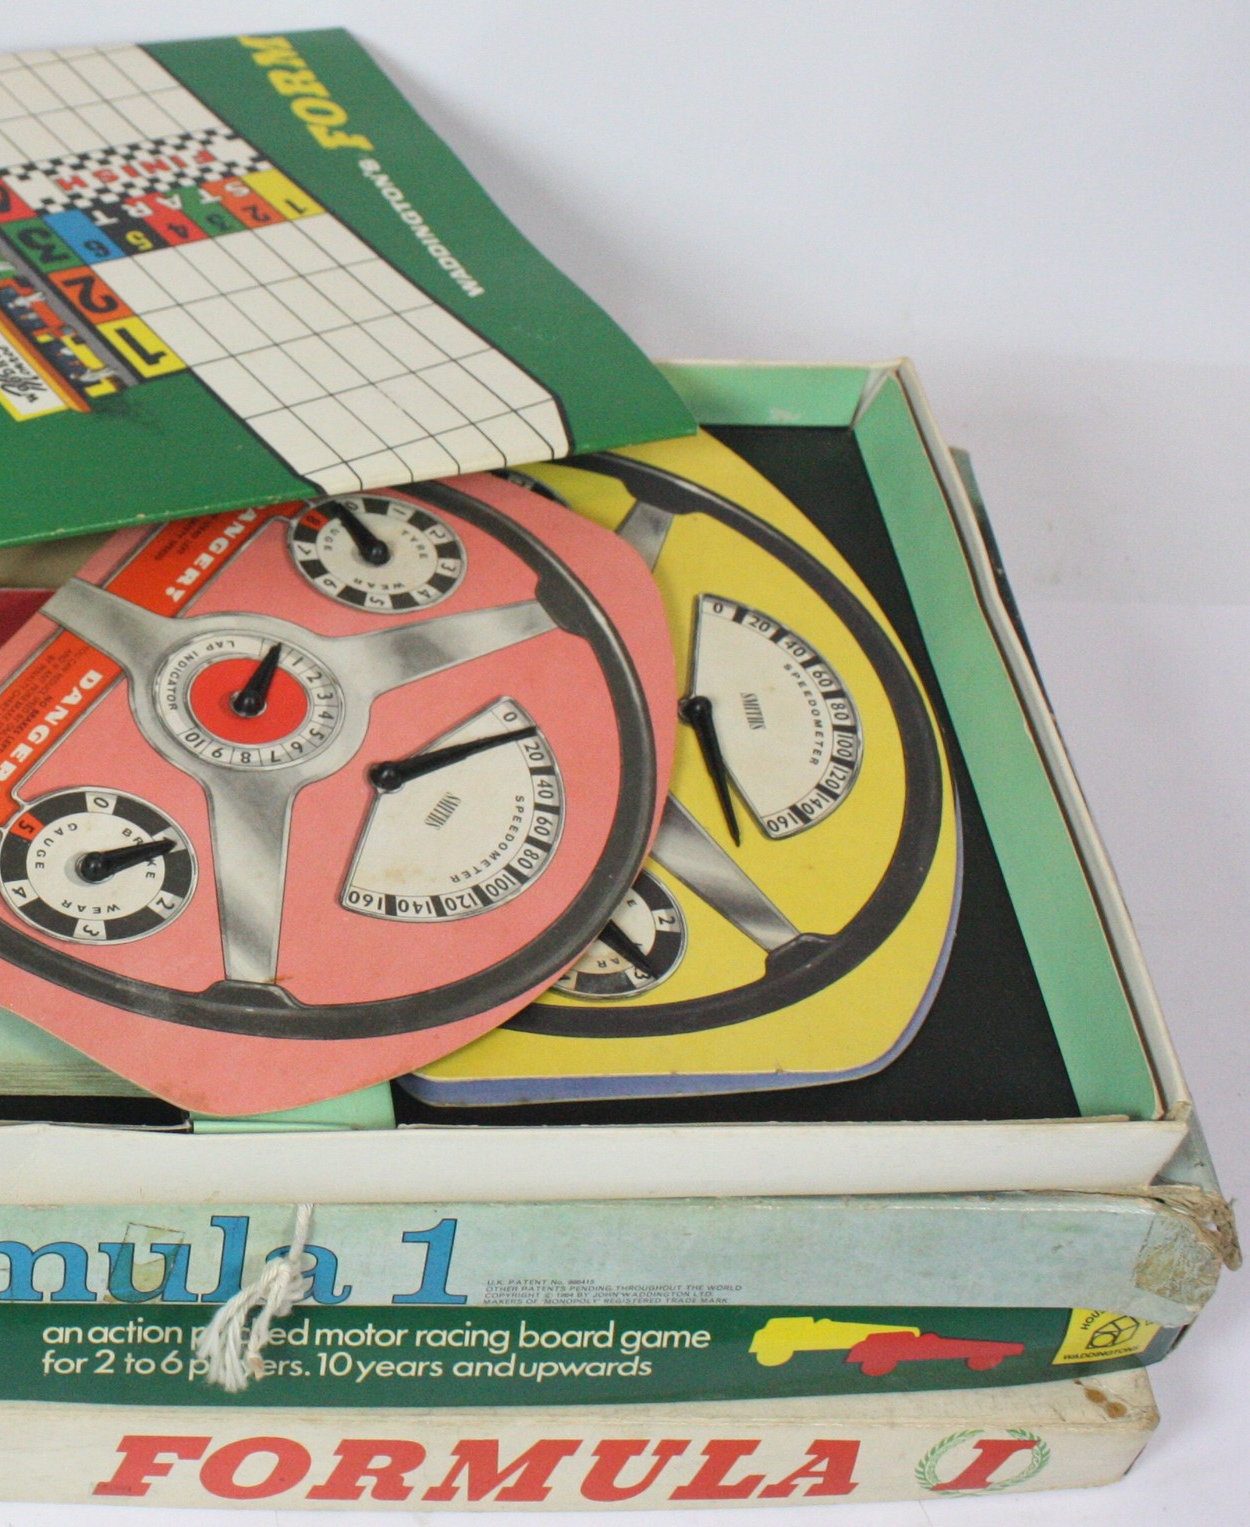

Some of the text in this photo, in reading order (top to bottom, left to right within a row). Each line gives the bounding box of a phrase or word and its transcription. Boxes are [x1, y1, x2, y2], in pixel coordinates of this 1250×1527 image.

[237, 35, 375, 151] FORM
[56, 148, 217, 192] FINISH
[92, 180, 250, 227] START
[241, 205, 271, 223] 2
[284, 199, 310, 216] 1
[166, 222, 191, 239] 4
[206, 213, 235, 231] 3
[358, 158, 485, 298] WADDINGTON'S
[16, 226, 70, 265] 3
[83, 239, 112, 258] 6
[125, 231, 154, 251] 5
[62, 275, 119, 314] 2
[115, 326, 168, 368] 1
[165, 506, 260, 602] ANGER!
[400, 529, 430, 560] TYRE
[353, 577, 406, 590] WEAR
[712, 602, 724, 614] 0
[750, 617, 770, 633] 20
[784, 640, 807, 658] 40
[166, 640, 236, 711] LAP INDICATOR
[812, 670, 833, 689] 60
[503, 711, 518, 723] 0
[740, 692, 767, 731] SMITHS
[783, 662, 825, 767] SPEEDOMETER
[830, 702, 850, 721] 80
[184, 732, 206, 749] 10
[523, 741, 544, 762] 20
[837, 733, 855, 758] 100
[536, 778, 554, 800] 40
[825, 766, 850, 790] 120
[424, 791, 462, 831] SMITHS
[800, 792, 830, 816] 140
[533, 815, 554, 837] 60
[766, 811, 799, 833] 160
[35, 821, 78, 870] GAUGE
[450, 795, 525, 884] SPEEDOMETER
[121, 827, 158, 879] BRKE
[517, 848, 540, 870] 80
[485, 872, 518, 898] 100
[61, 899, 121, 915] WEAR
[348, 891, 384, 911] 160
[397, 899, 433, 915] 140
[444, 892, 478, 912] 120
[391, 1217, 468, 1305] 1
[42, 1324, 83, 1345] an
[87, 1316, 183, 1345] action
[314, 1322, 408, 1347] motor
[415, 1320, 510, 1354] racing
[518, 1319, 615, 1349] board
[620, 1329, 711, 1356] game
[42, 1350, 88, 1377] for
[93, 1350, 116, 1375] 2
[124, 1353, 145, 1375] to
[160, 1350, 183, 1376] 6
[316, 1352, 352, 1377] 10
[355, 1357, 444, 1384] years
[452, 1352, 517, 1378] and
[518, 1355, 653, 1383] upwards
[91, 1434, 862, 1503] FORMULA
